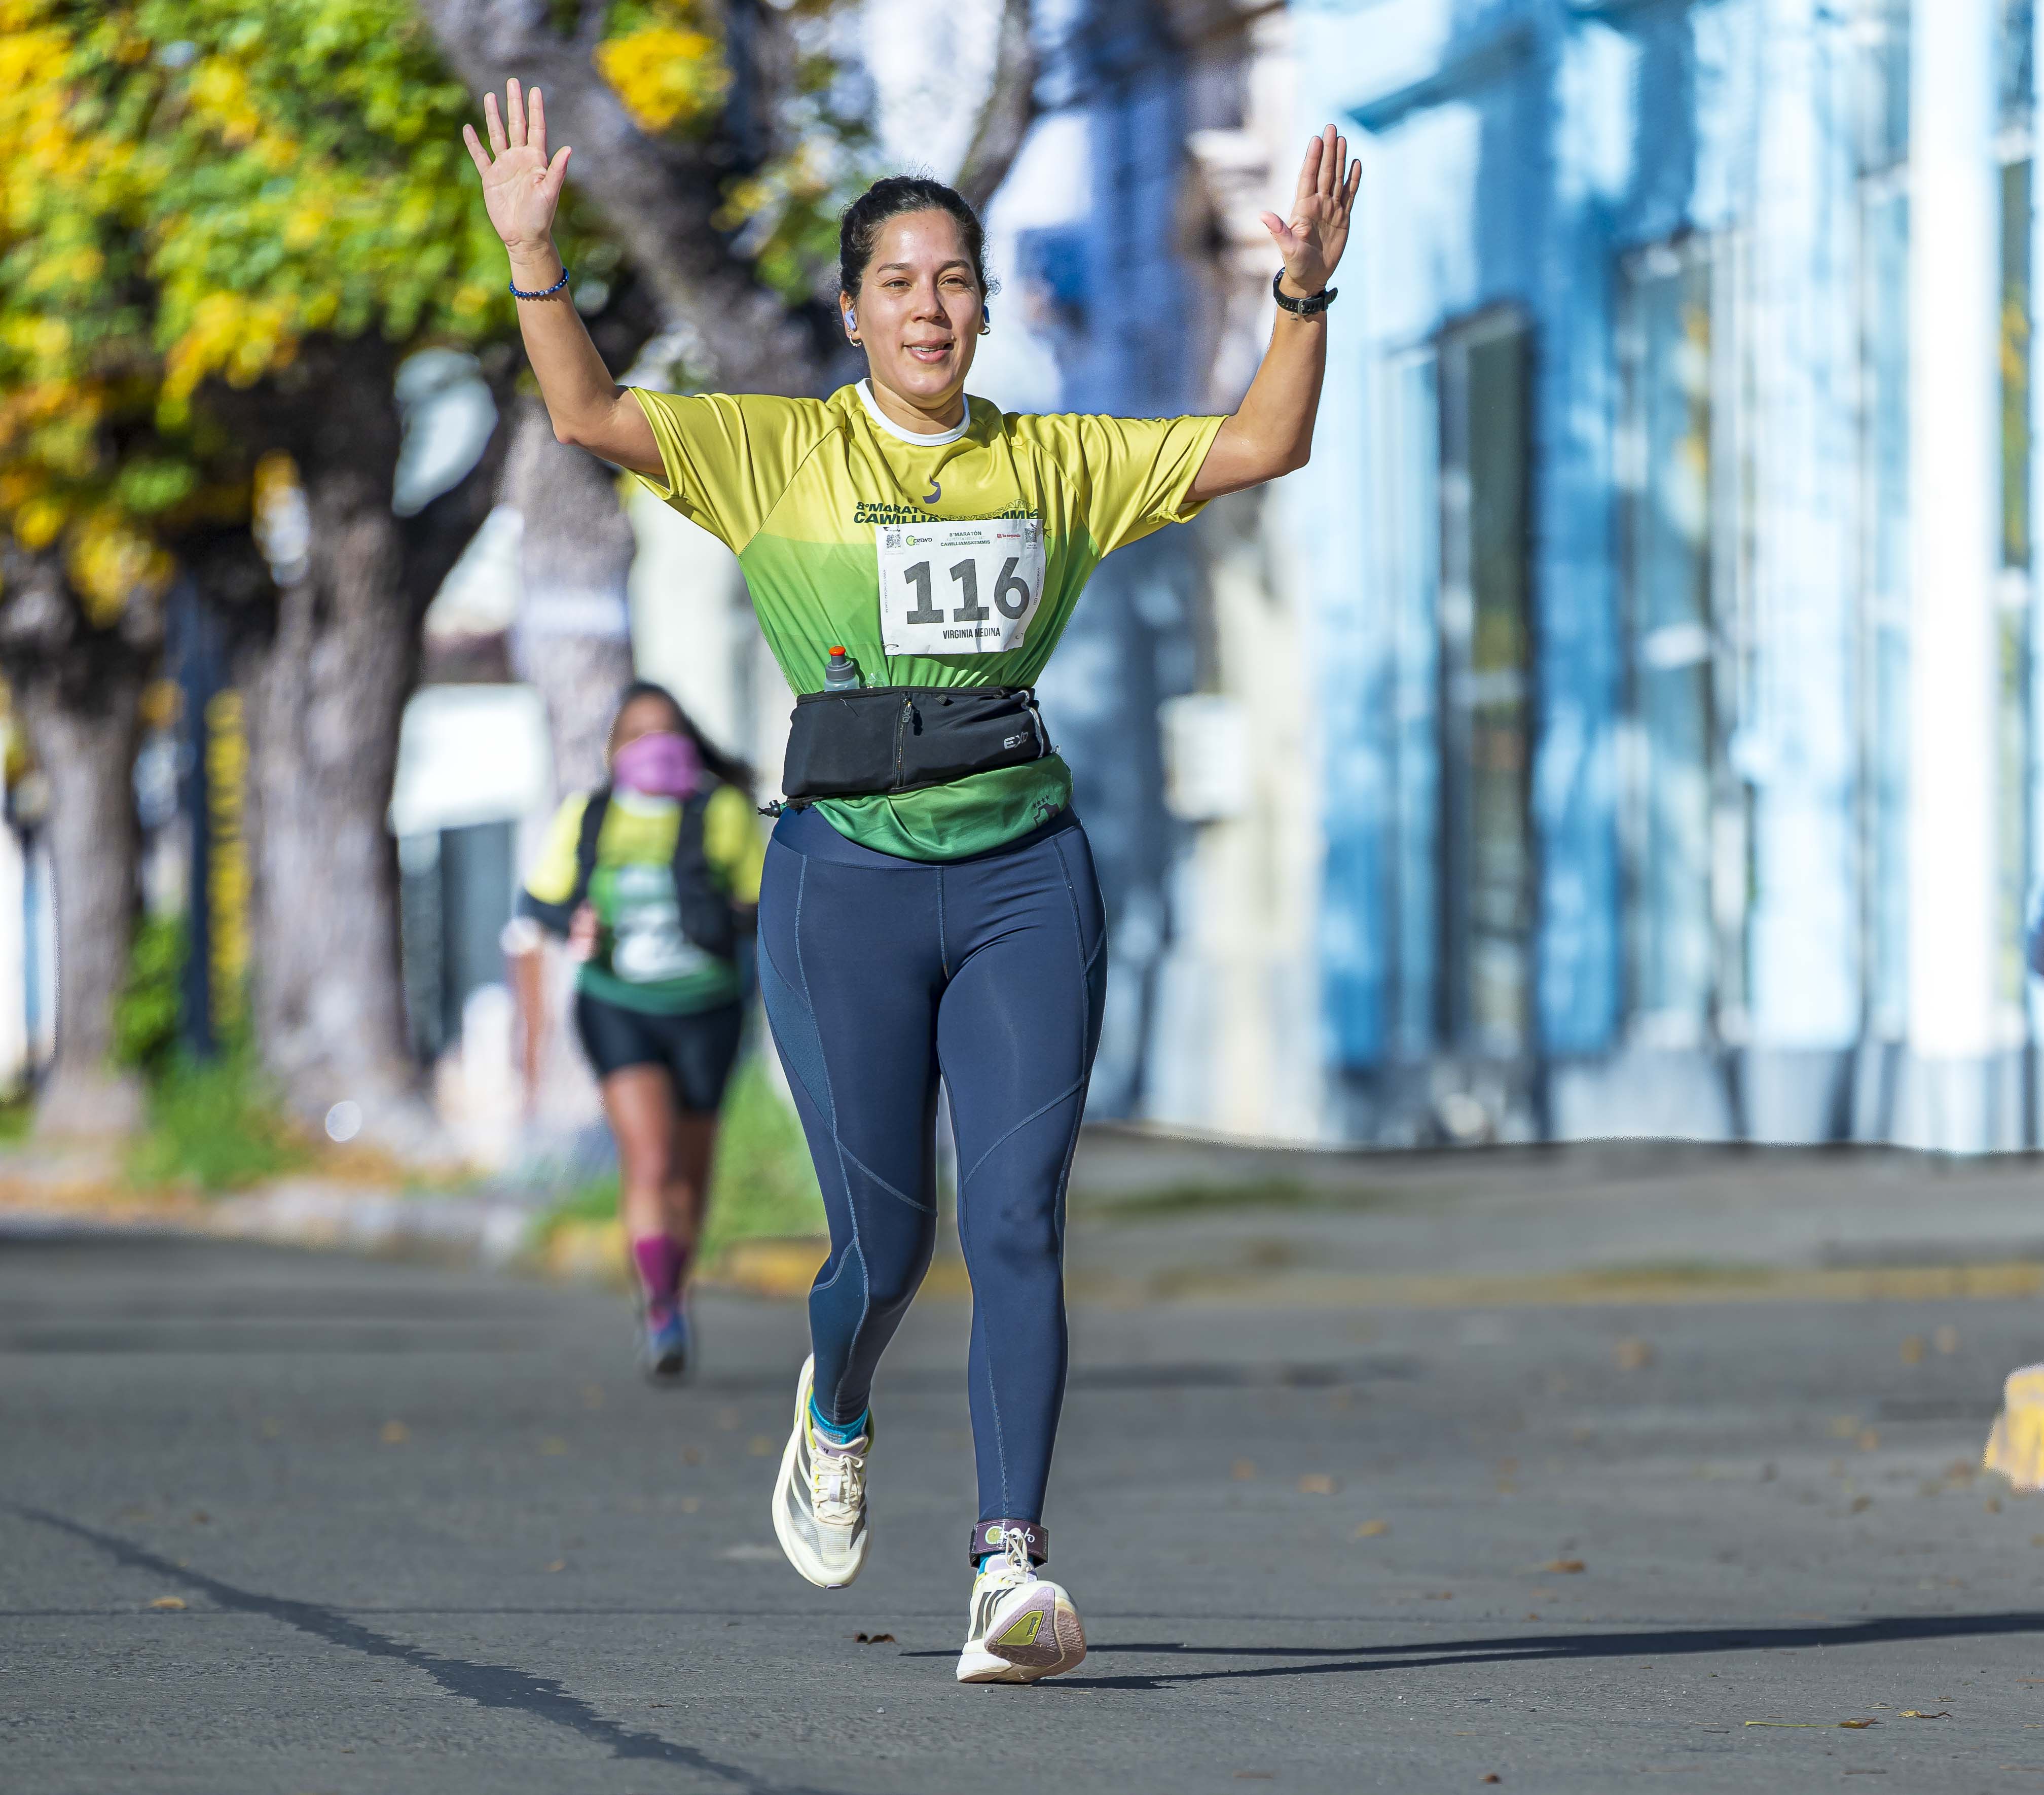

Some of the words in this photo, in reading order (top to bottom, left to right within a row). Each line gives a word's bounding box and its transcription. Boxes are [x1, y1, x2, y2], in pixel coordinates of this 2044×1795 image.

[904, 557, 1030, 624] 116
[943, 629, 973, 639] VIRGINIA
[975, 628, 1001, 637] MEDINA
